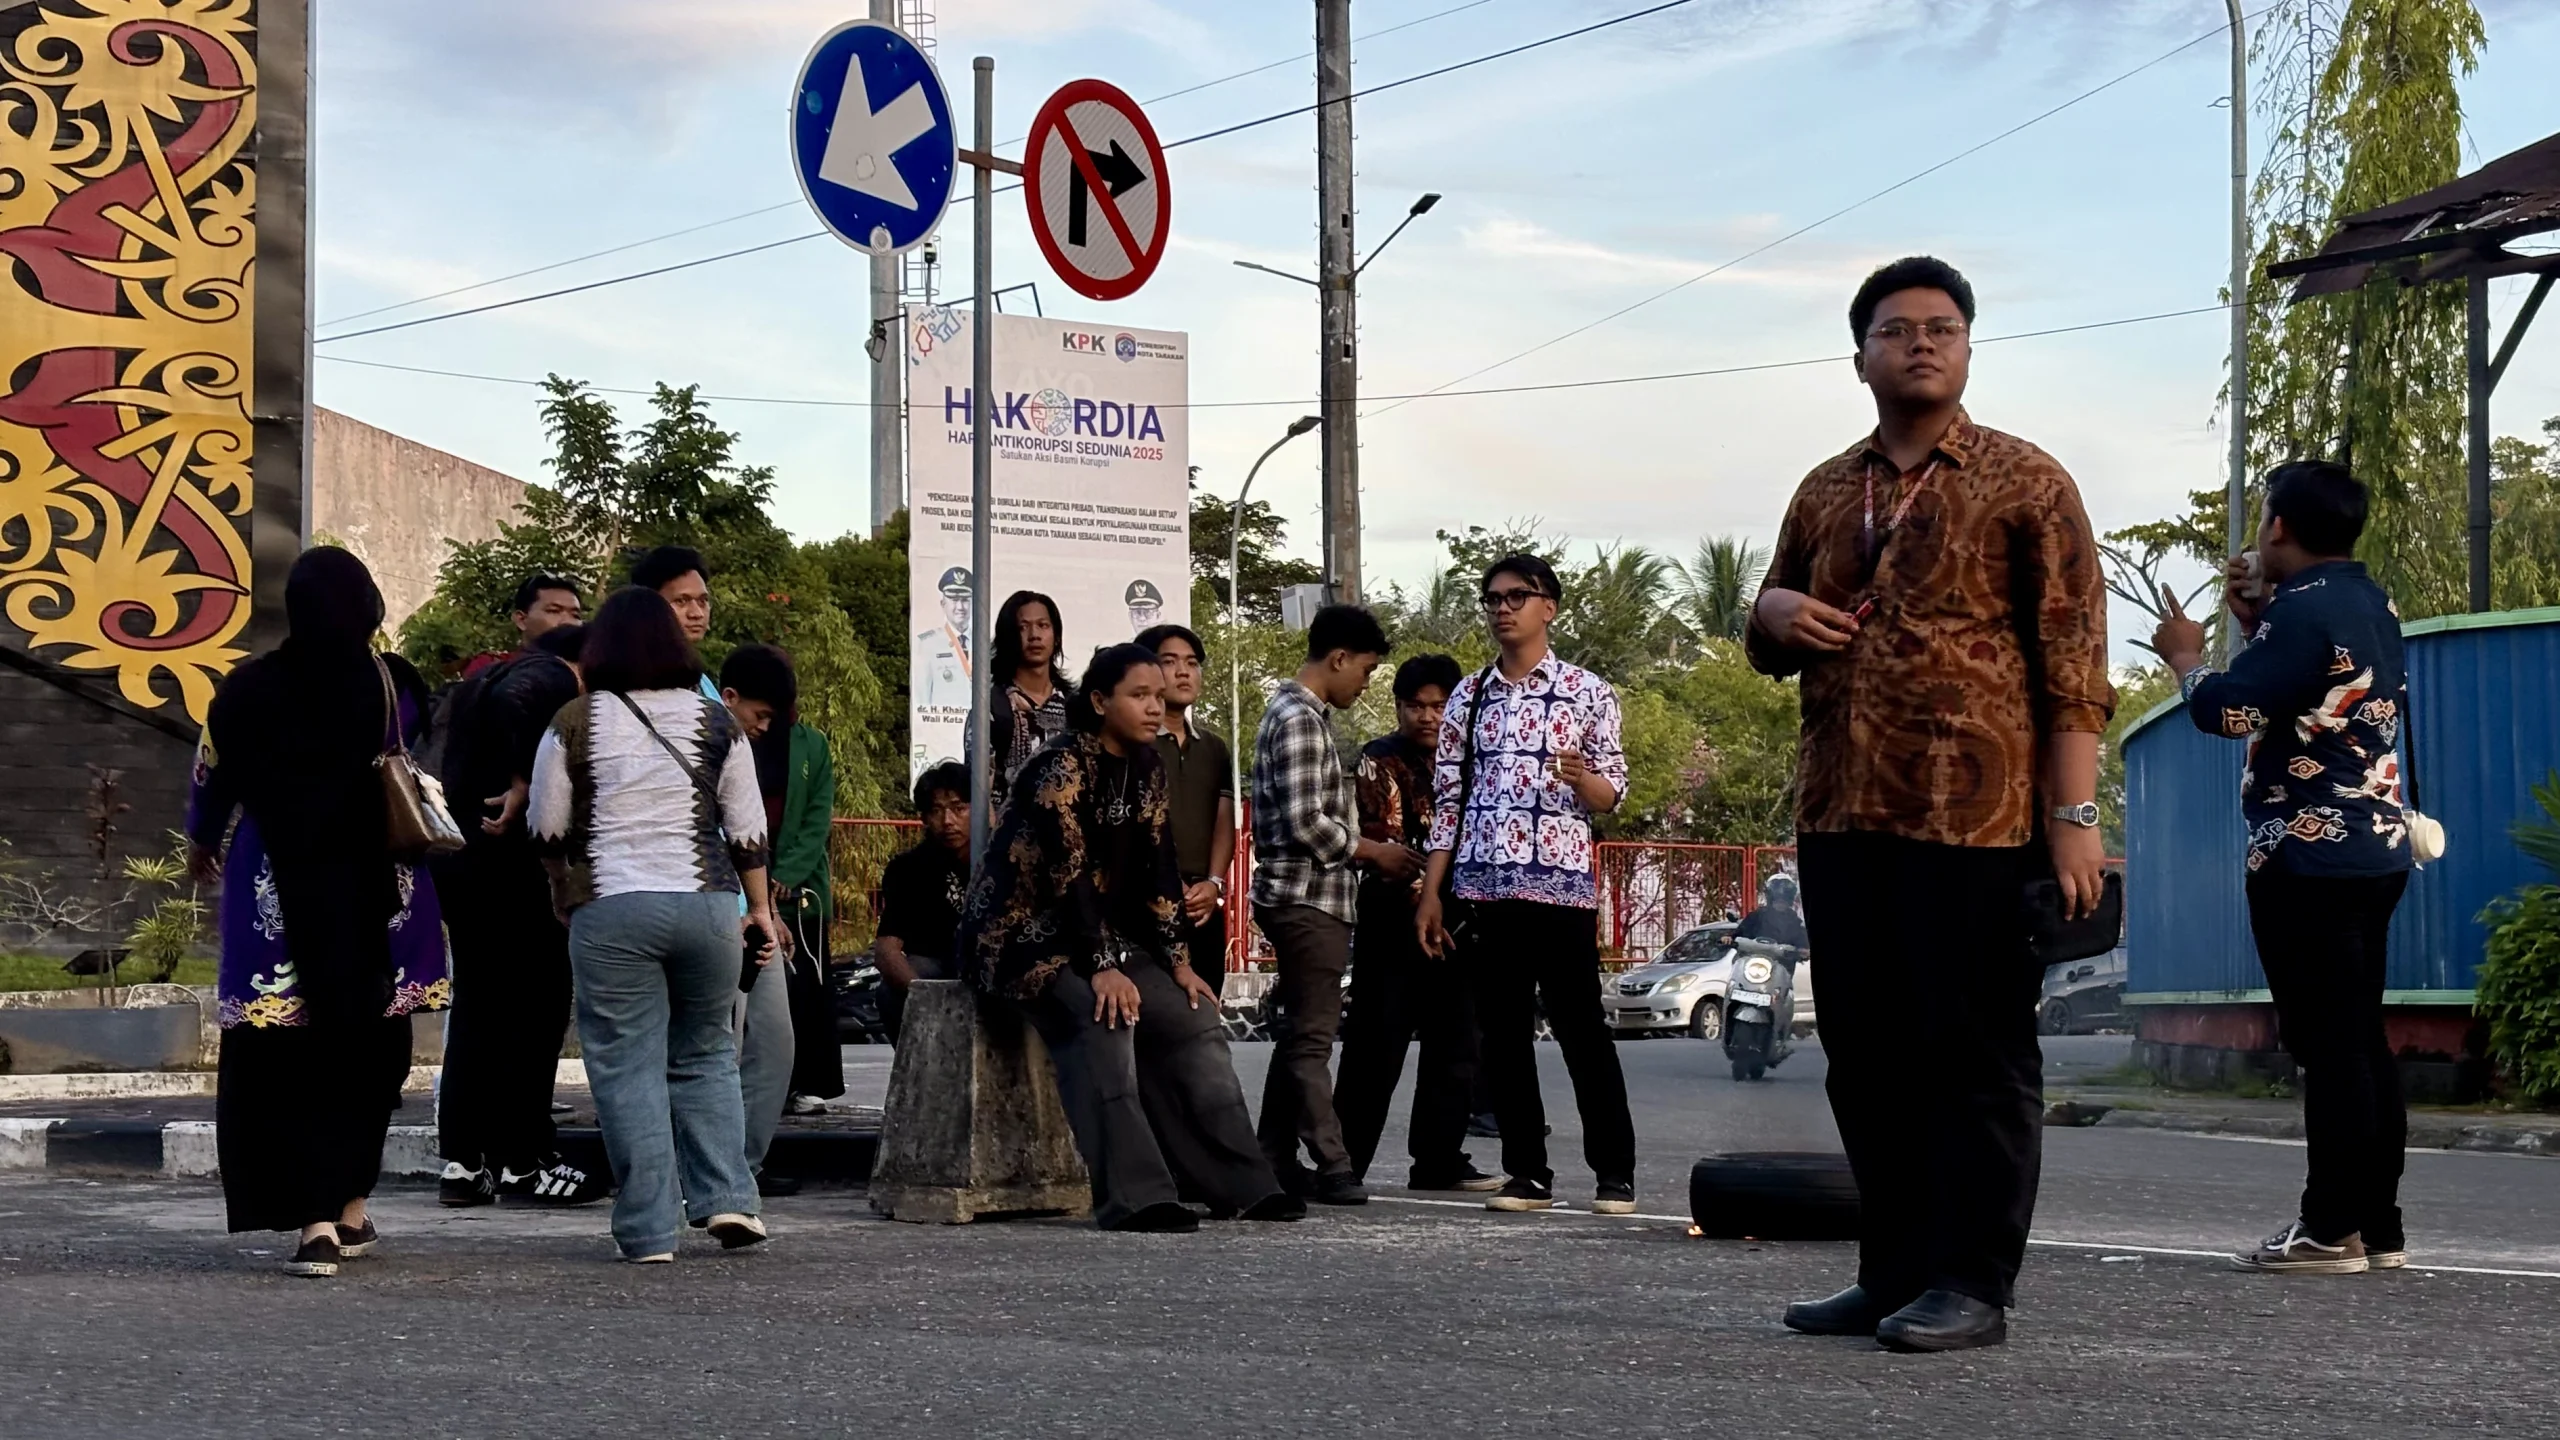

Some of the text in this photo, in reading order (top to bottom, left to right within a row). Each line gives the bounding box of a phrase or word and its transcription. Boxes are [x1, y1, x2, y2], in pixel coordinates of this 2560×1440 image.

[1062, 332, 1106, 352] KPK
[1000, 449, 1110, 468] Satukan Aksi Basmi Korupsi
[1076, 441, 1132, 458] SEDUNIA
[1133, 446, 1163, 460] 2025
[947, 508, 959, 517] DAN
[999, 512, 1019, 521] UNTUK
[1022, 499, 1035, 508] DARI
[1158, 509, 1177, 519] SETIAP
[941, 522, 956, 531] MARI
[1034, 528, 1049, 538] KOTA
[930, 705, 940, 713] H.
[922, 715, 964, 723] Wali Kota
